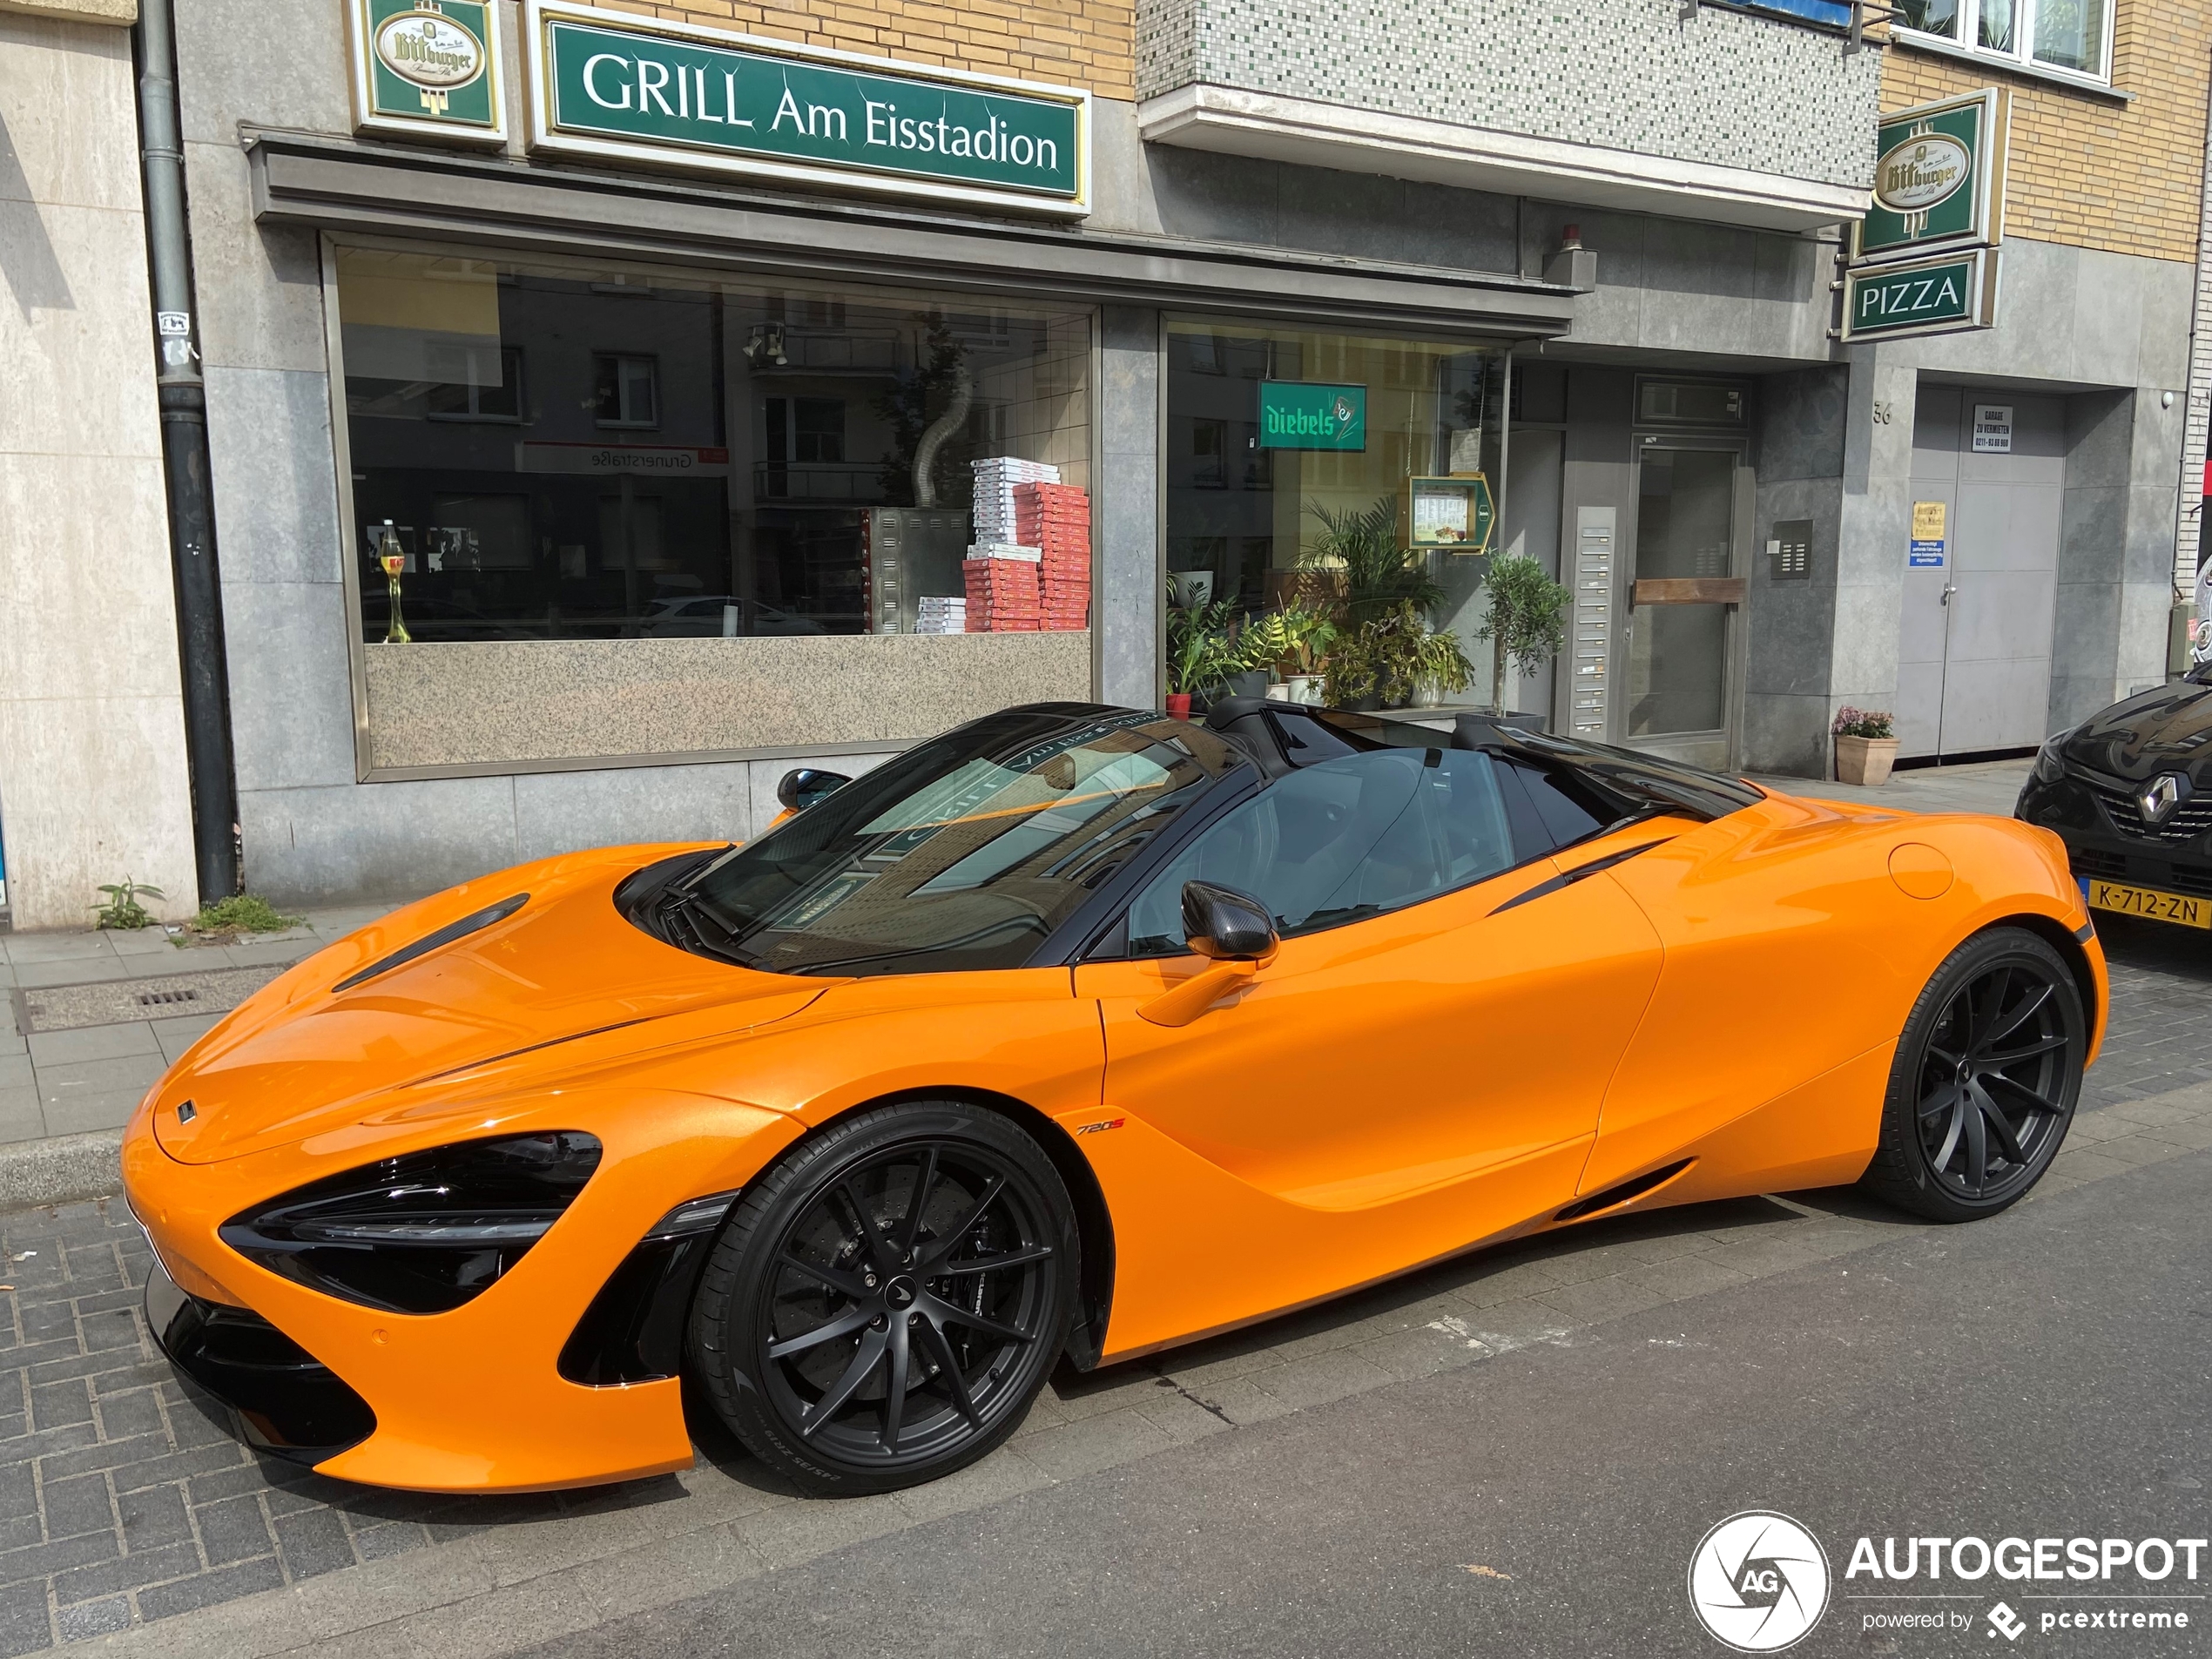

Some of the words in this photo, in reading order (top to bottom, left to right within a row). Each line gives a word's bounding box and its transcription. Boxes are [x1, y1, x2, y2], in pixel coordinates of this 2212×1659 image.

[394, 31, 471, 71] Bitburger
[583, 52, 756, 132] GRILL
[766, 77, 849, 144] Am
[862, 91, 1060, 172] Eisstadion
[1885, 161, 1957, 193] Bitburger
[1861, 276, 1960, 317] PIZZA
[1873, 401, 1892, 425] 36
[2100, 885, 2198, 922] K-712-ZN
[1076, 1117, 1126, 1136] 720S
